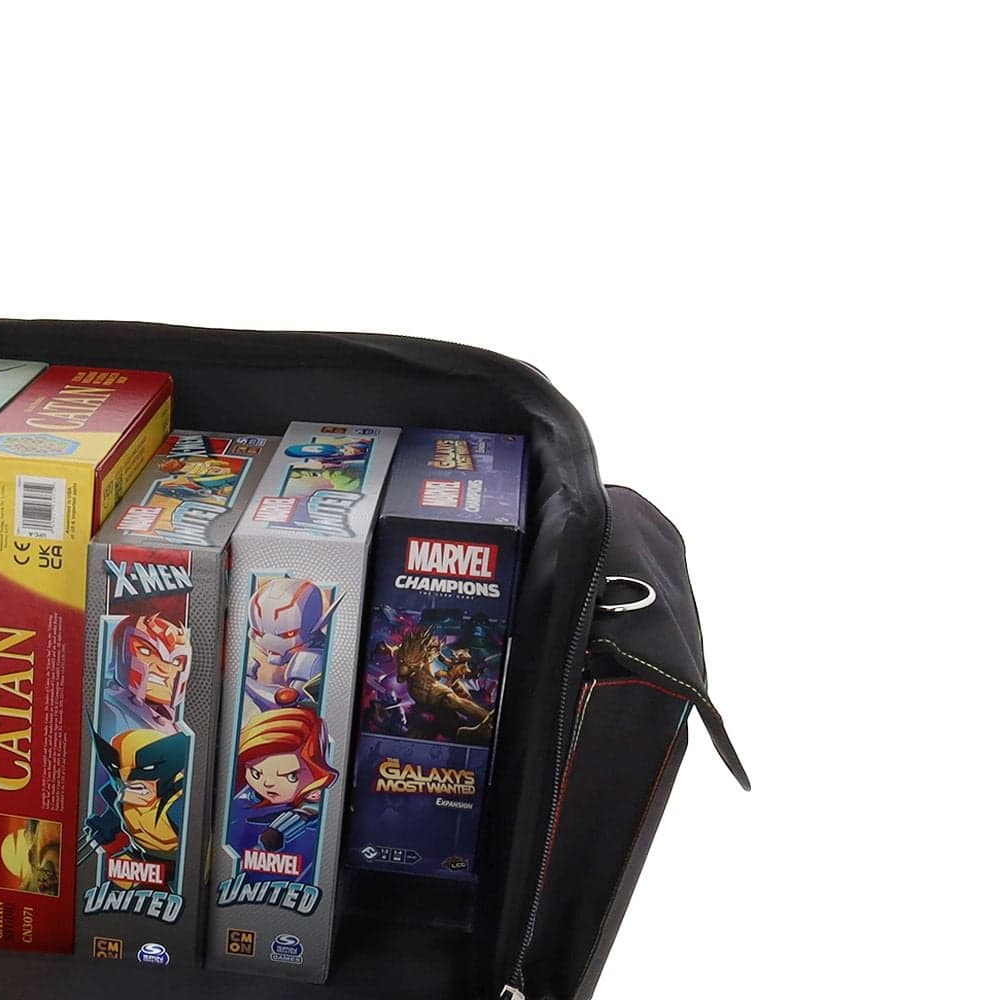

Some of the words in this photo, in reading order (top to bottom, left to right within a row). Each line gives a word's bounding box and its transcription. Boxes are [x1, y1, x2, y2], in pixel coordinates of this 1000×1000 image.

[26, 385, 117, 431] CATAN
[38, 544, 51, 569] UK
[51, 545, 63, 570] CA
[408, 541, 493, 578] MARVEL
[104, 560, 193, 598] X-MEN
[394, 575, 500, 599] CHAMPIONS
[376, 779, 425, 793] MOST
[426, 782, 475, 795] WANTED
[108, 859, 163, 884] MARVEL
[243, 850, 300, 875] MARVEL
[83, 886, 184, 923] UNITED
[217, 874, 320, 915] UNITED
[22, 907, 33, 943] CN3071
